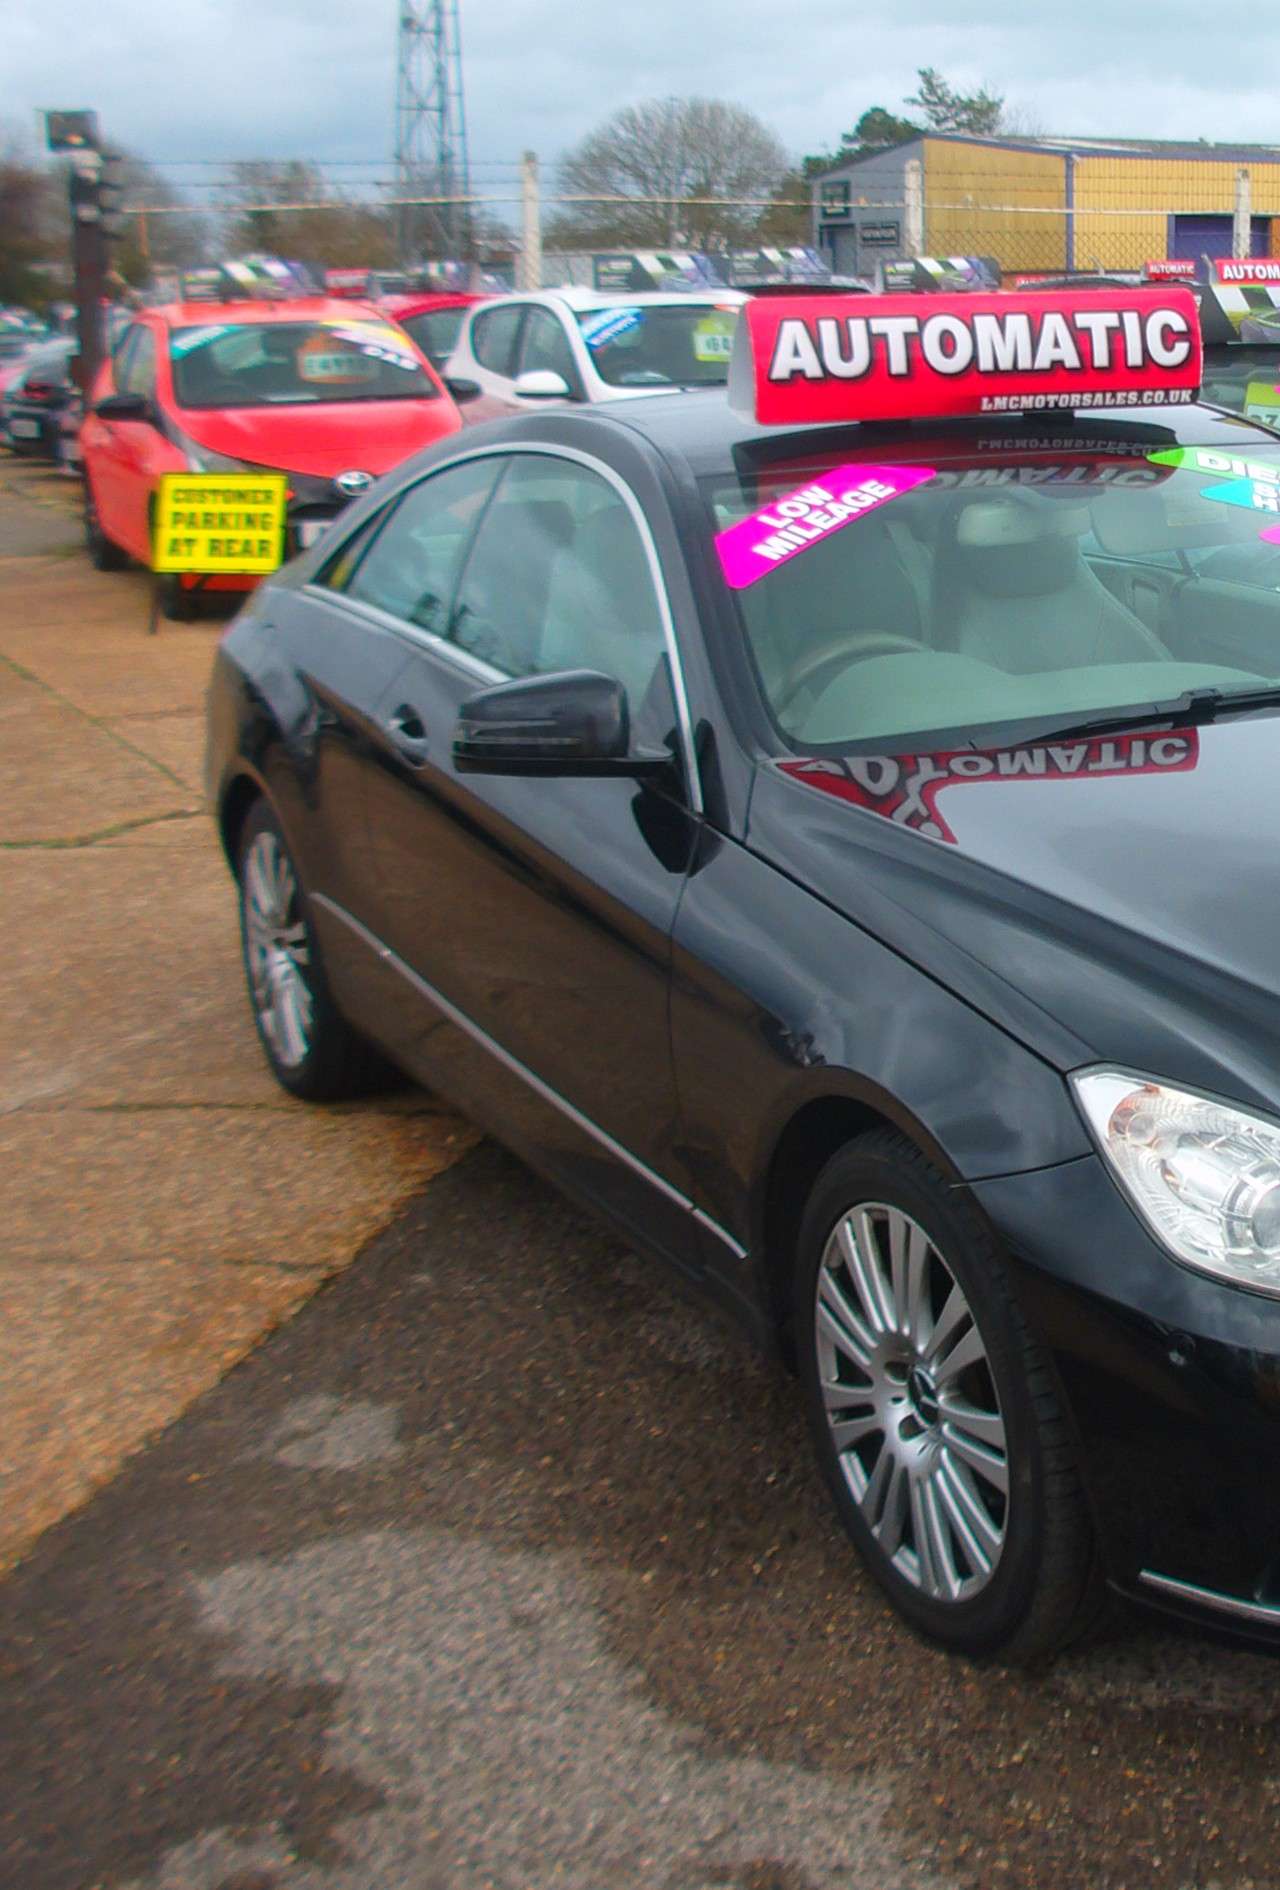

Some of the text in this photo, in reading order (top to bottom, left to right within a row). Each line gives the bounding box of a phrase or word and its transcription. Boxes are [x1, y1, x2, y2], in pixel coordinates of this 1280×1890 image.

[1150, 263, 1195, 275] AUTOMATIC
[768, 308, 1192, 381] AUTOMATIC
[980, 389, 1193, 411] LMCMOTORSALES.CO.UK
[172, 489, 274, 505] CUSTOMER
[757, 485, 835, 529] LOW
[170, 511, 273, 531] PARKING
[752, 479, 897, 561] MILEAGE
[168, 538, 273, 560] AT REAR
